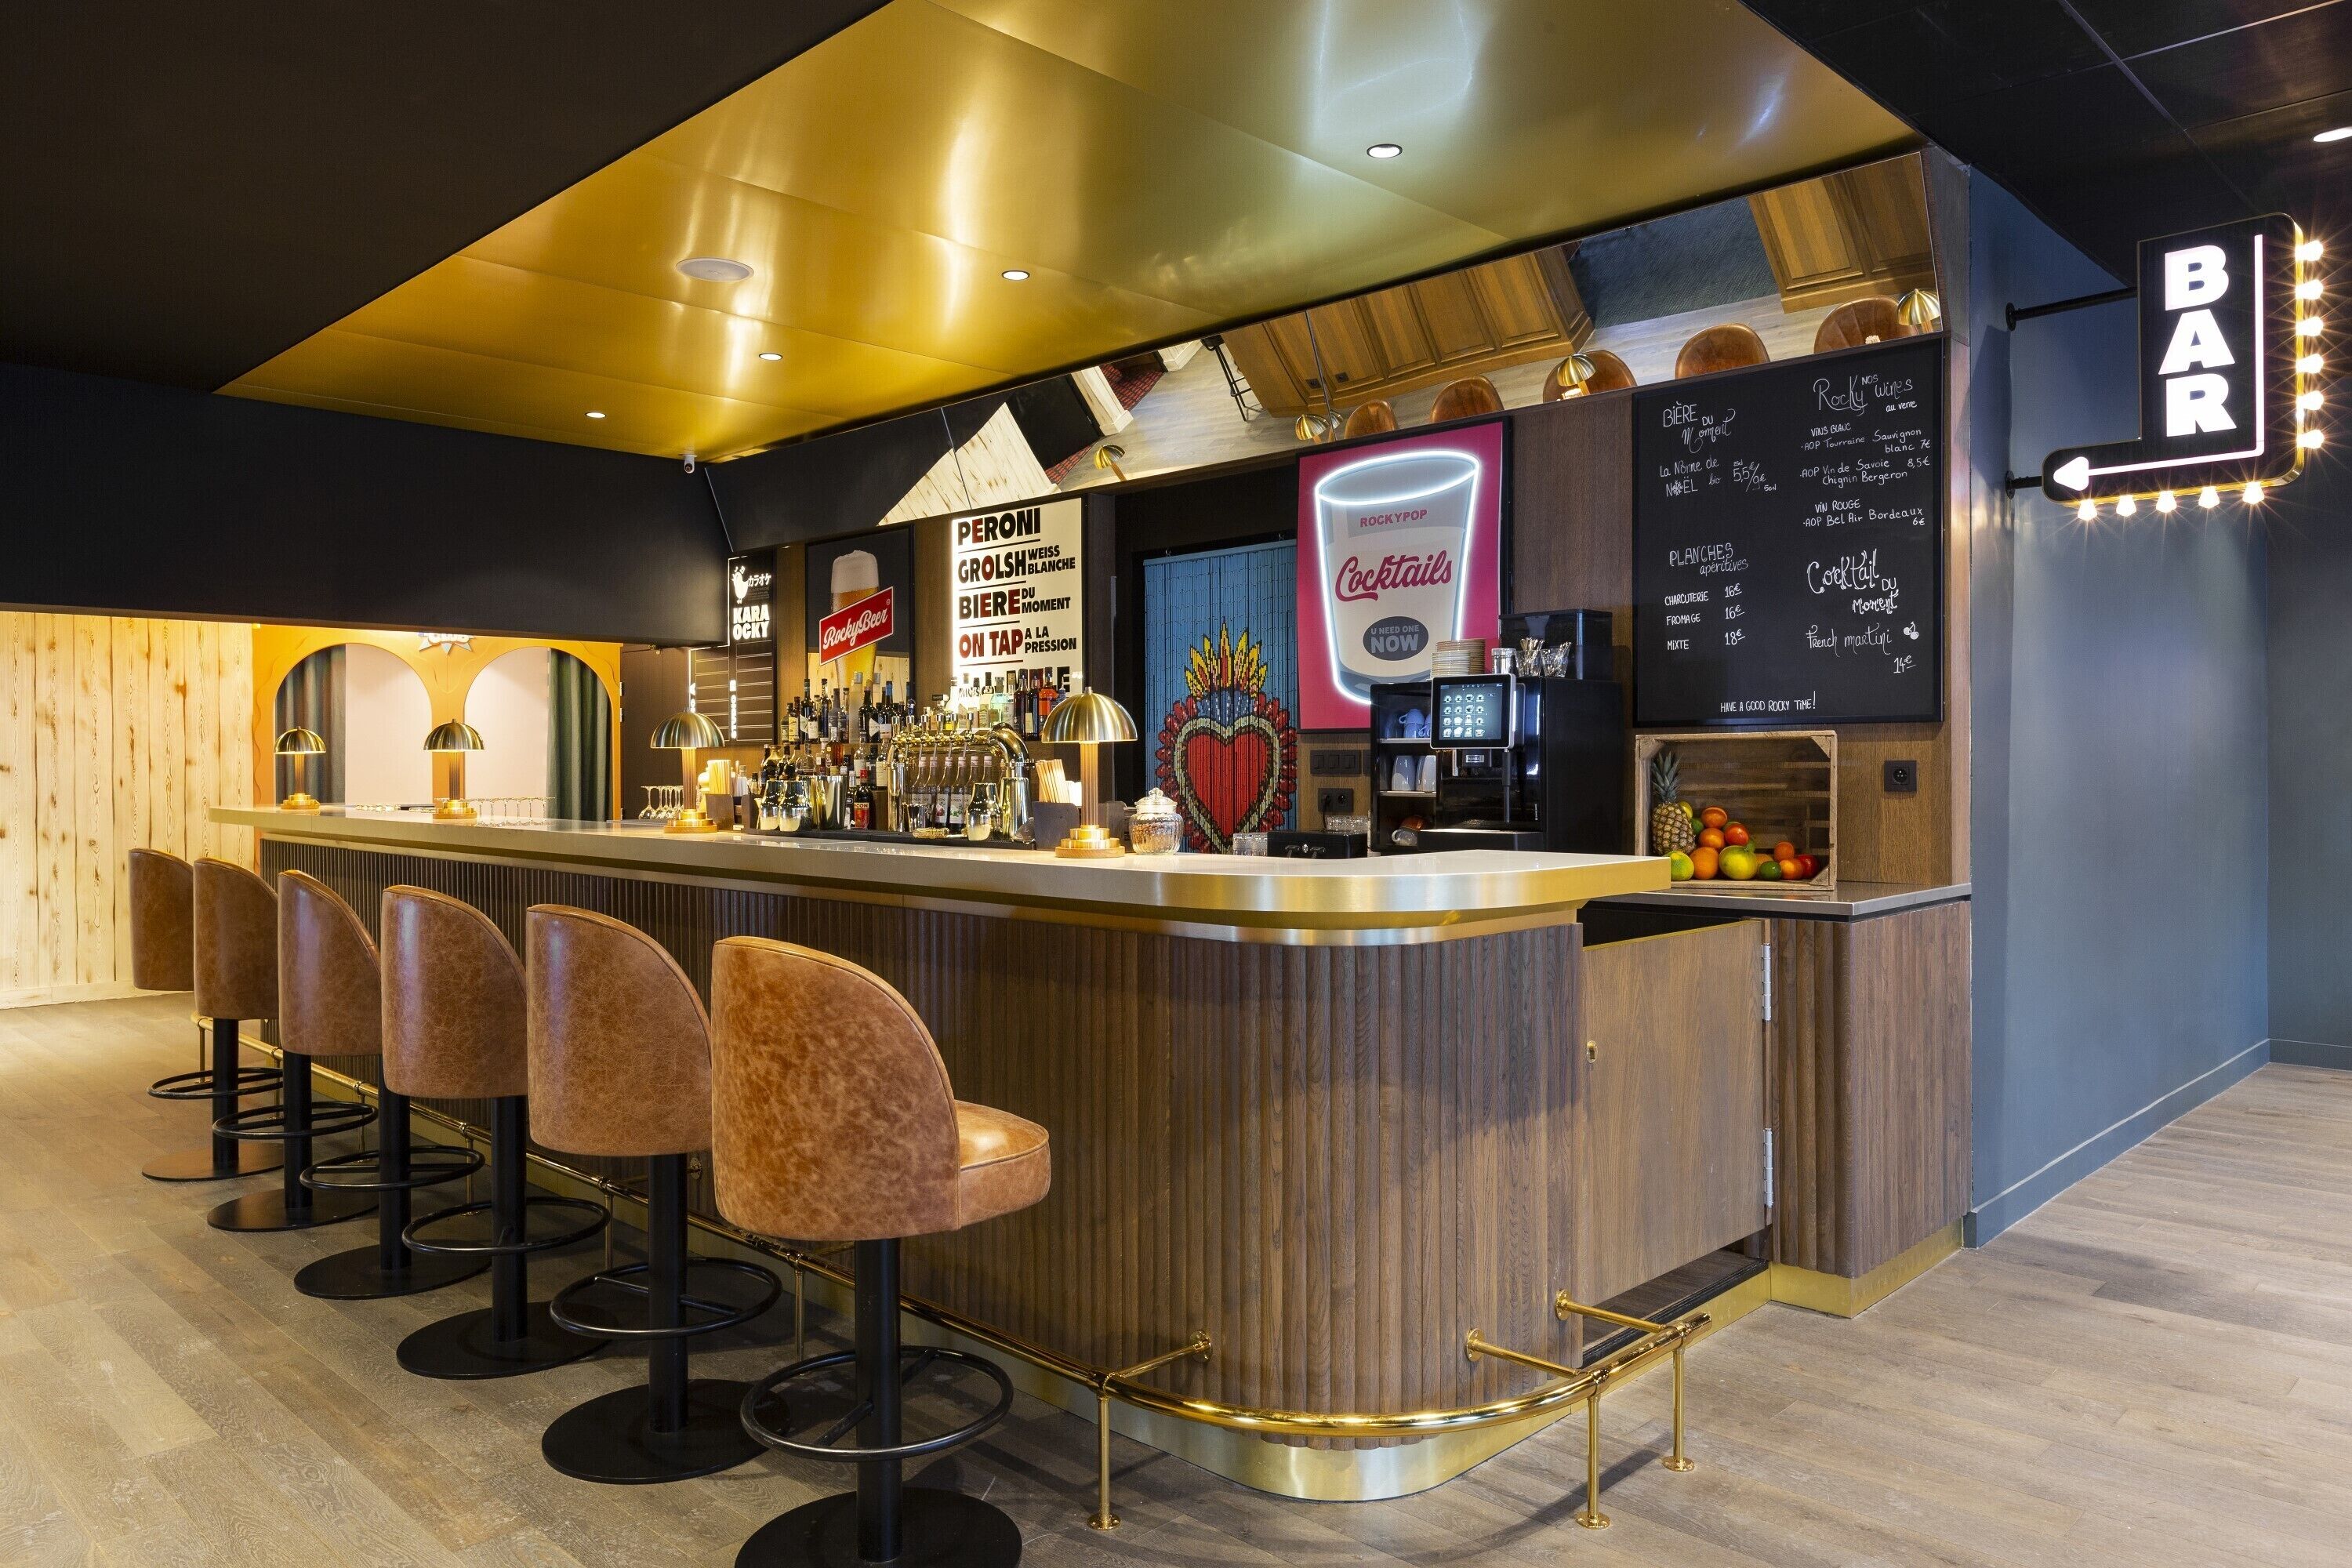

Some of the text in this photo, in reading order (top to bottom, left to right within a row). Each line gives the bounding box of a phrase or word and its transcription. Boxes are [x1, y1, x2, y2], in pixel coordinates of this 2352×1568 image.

[2158, 245, 2237, 437] BAR
[1862, 374, 1878, 385] NOS
[1886, 401, 1918, 412] au verre
[1702, 415, 1714, 426] DU
[1831, 423, 1852, 434] BLANC
[1804, 429, 1922, 451] AOP Tourraine Sauvignon
[1885, 443, 1915, 453] blanc
[1706, 455, 1719, 469] de
[1802, 456, 1931, 477] AOP Vin de Savoie 8,5€
[1708, 474, 1722, 485] bio
[1822, 470, 1907, 488] Chignin Bergeron
[1832, 499, 1860, 511] ROUGE
[1359, 509, 1428, 528] ROCKYPOP
[1806, 507, 1923, 527] AOP Bel Air Bordeaux
[1912, 517, 1926, 526] 6€
[958, 507, 1040, 546] PERONI
[1028, 545, 1060, 561] WEISS
[1669, 543, 1733, 567] PLANCHES
[958, 550, 1026, 584] GROLSH
[1028, 557, 1076, 575] BLANCHE
[1700, 558, 1749, 577] apéritives
[1334, 550, 1453, 602] Cocktails
[1882, 577, 1896, 591] DU
[1022, 586, 1035, 599] DU
[1725, 583, 1742, 598] 16€
[959, 589, 1020, 619] BIERE
[1022, 597, 1071, 614] MOMENT
[733, 604, 770, 624] KARA
[1666, 604, 1743, 626] FROMAGE 16€
[733, 621, 770, 641] OCKY
[1025, 626, 1049, 639] A LA
[1379, 626, 1400, 634] NEED
[1725, 629, 1743, 645] 18€
[959, 629, 1023, 659] ON TAP
[1025, 637, 1076, 654] PRESSION
[1371, 634, 1419, 653] NOW
[1893, 655, 1915, 673] 14€
[1720, 702, 1737, 713] HAVE
[1739, 701, 1744, 712] A
[1745, 700, 1766, 711] GOOD
[1768, 699, 1790, 711] ROCKY
